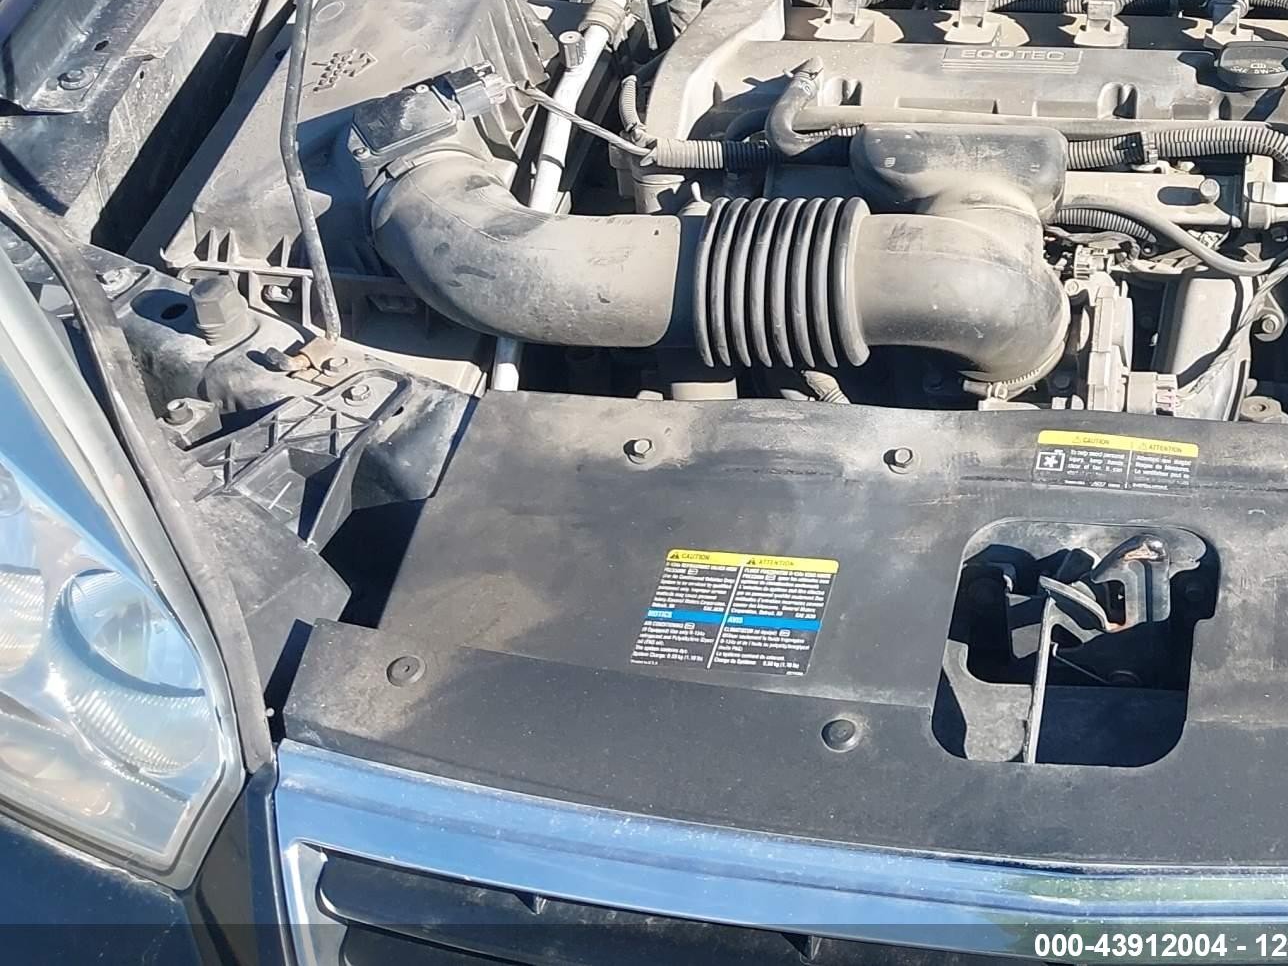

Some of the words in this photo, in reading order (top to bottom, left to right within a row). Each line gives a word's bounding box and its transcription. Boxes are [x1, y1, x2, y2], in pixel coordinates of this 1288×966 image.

[961, 49, 1065, 61] ECOTEC
[1083, 436, 1110, 445] CAUTION
[1148, 444, 1182, 453] ATTENTION
[758, 559, 795, 567] ATTENTION
